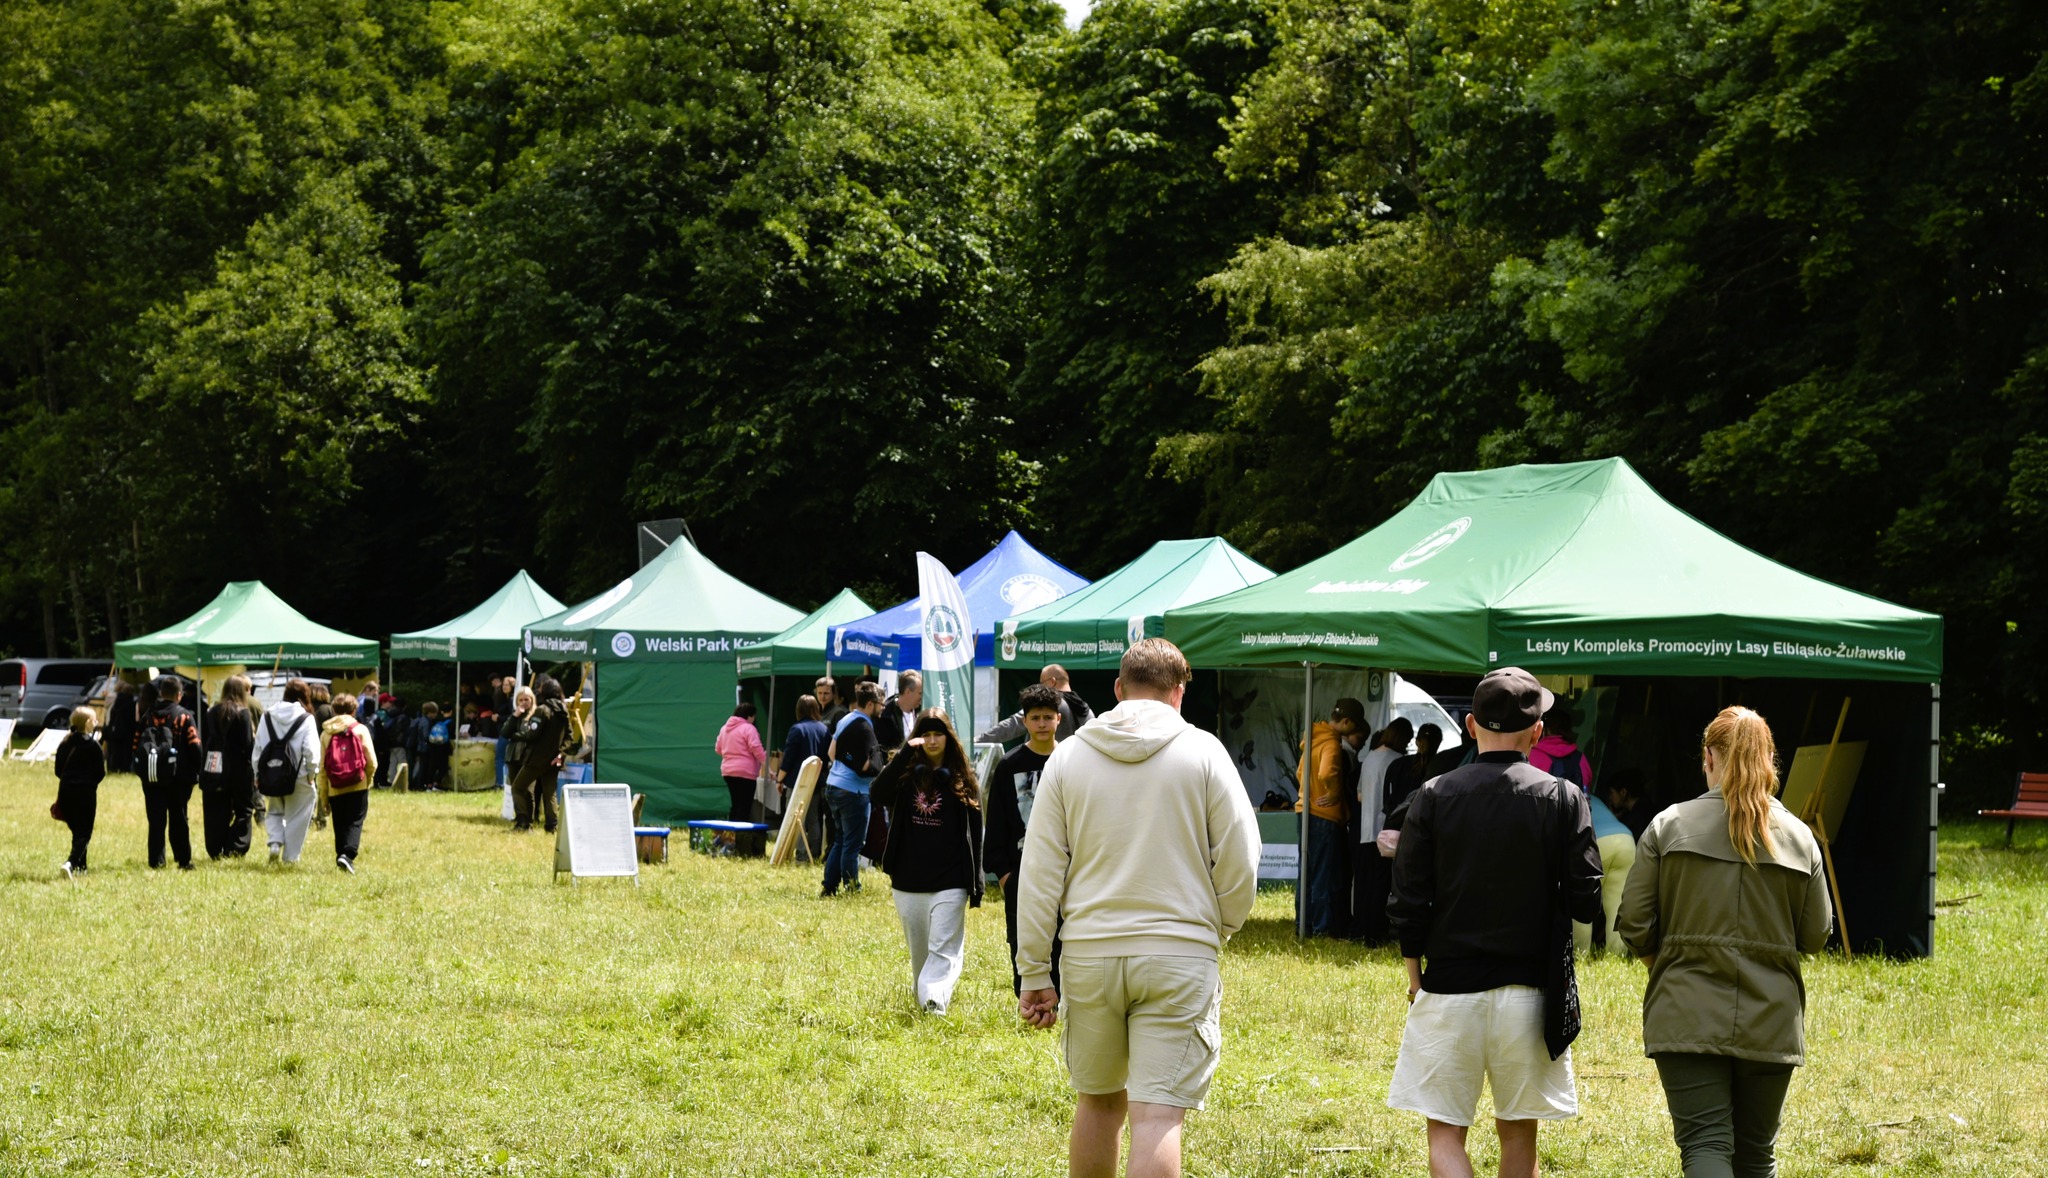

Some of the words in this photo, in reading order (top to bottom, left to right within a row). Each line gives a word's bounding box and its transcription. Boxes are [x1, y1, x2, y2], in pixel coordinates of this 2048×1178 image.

[645, 637, 693, 652] Welski
[697, 637, 730, 652] Park
[1241, 632, 1257, 646] Leśny
[1310, 632, 1325, 646] Lasy
[1019, 640, 1031, 652] Park
[1031, 640, 1066, 655] Krajobrazowy
[1066, 640, 1098, 655] Wysoczyzny
[1526, 638, 1571, 656] Leśny
[1574, 638, 1645, 656] Kompleks
[1648, 638, 1733, 657] Promocyjny
[1736, 640, 1770, 656] Lasy
[1773, 640, 1907, 661] Elbląsko-Żuławskie
